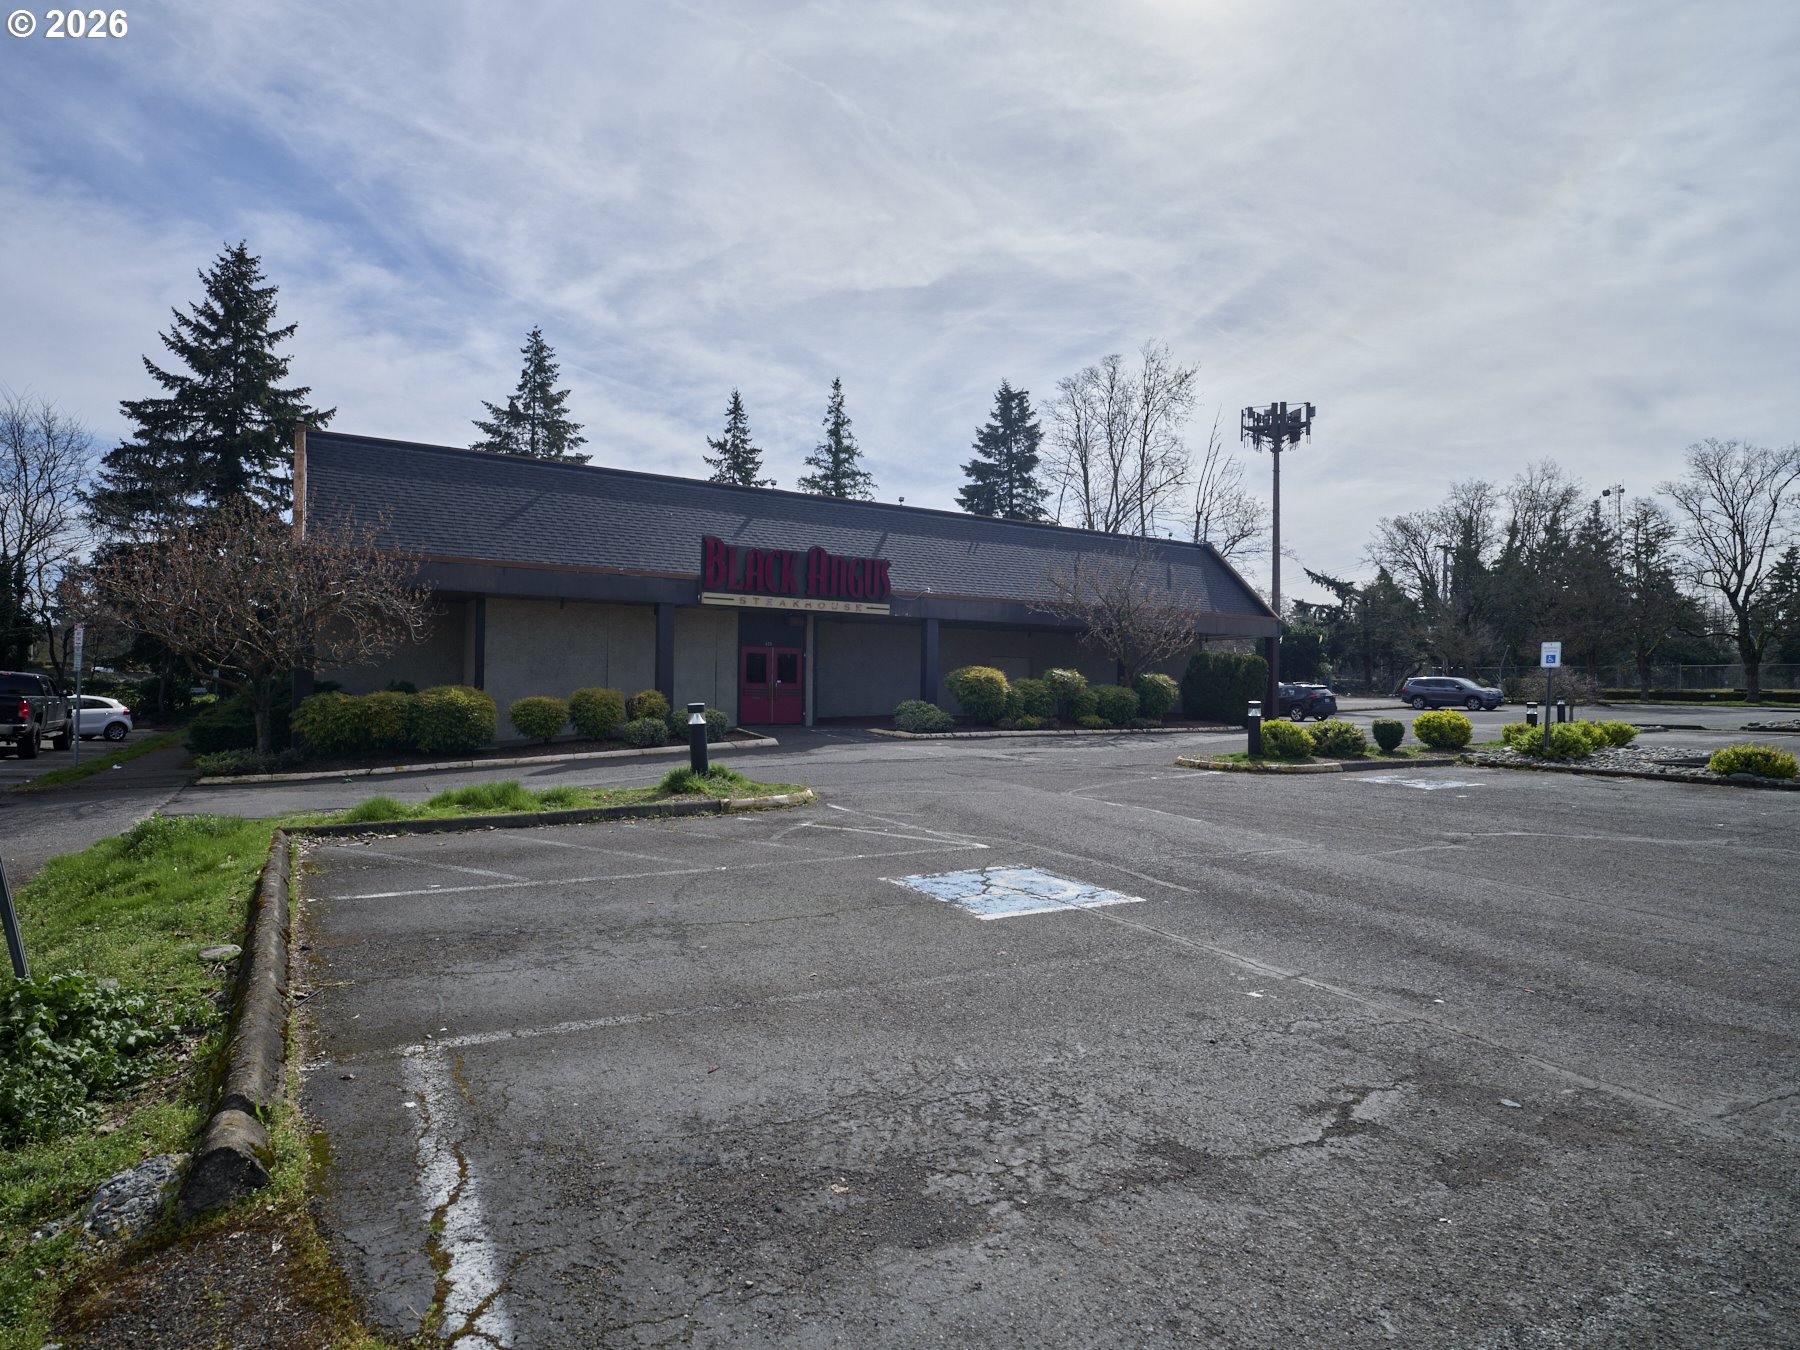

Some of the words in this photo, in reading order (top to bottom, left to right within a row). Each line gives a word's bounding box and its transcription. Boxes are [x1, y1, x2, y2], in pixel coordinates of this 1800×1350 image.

[704, 535, 799, 594] BLACK
[806, 546, 891, 599] ANGUS
[738, 596, 863, 612] STEAKHOUSE
